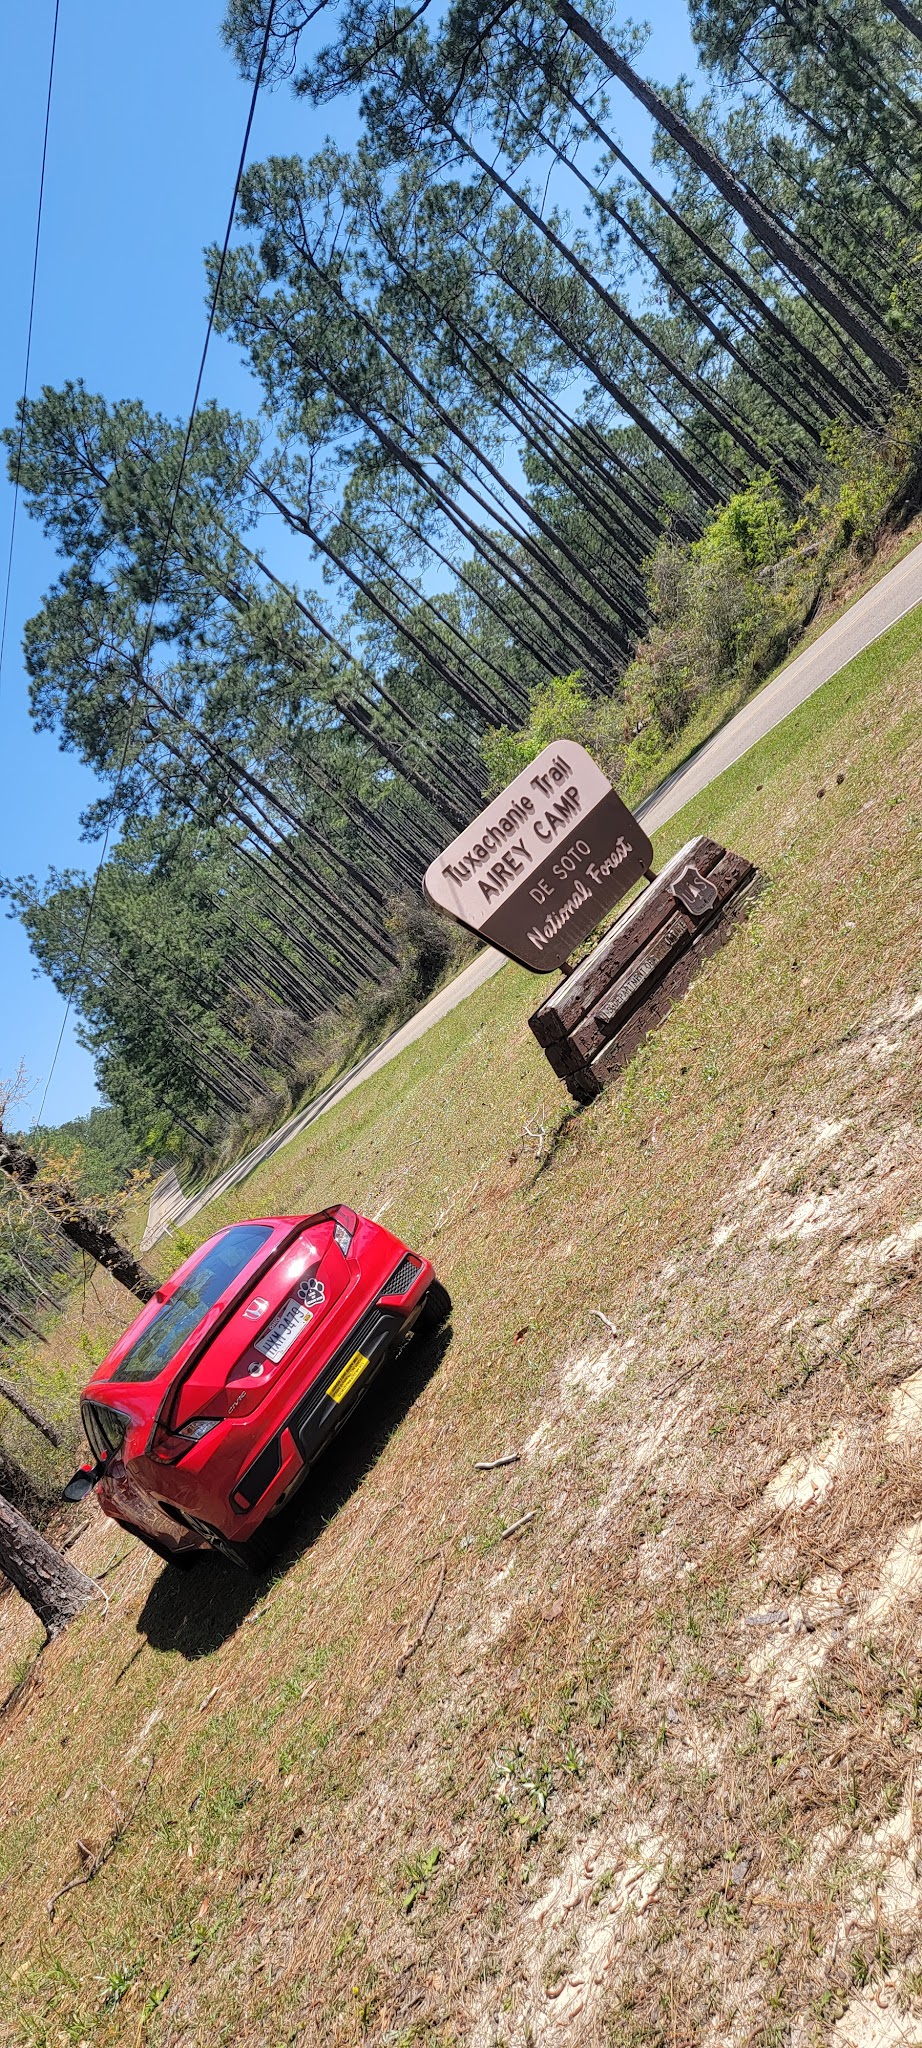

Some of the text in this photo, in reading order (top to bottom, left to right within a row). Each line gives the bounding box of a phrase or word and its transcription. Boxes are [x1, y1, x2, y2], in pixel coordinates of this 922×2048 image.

[441, 754, 573, 887] Tuxachanie Trail
[477, 785, 582, 905] AIREY CAMP
[526, 836, 633, 951] National Forest
[528, 839, 591, 905] DE SOTO
[262, 1306, 304, 1355] HXM 3479
[228, 1391, 247, 1414] CIVIC
